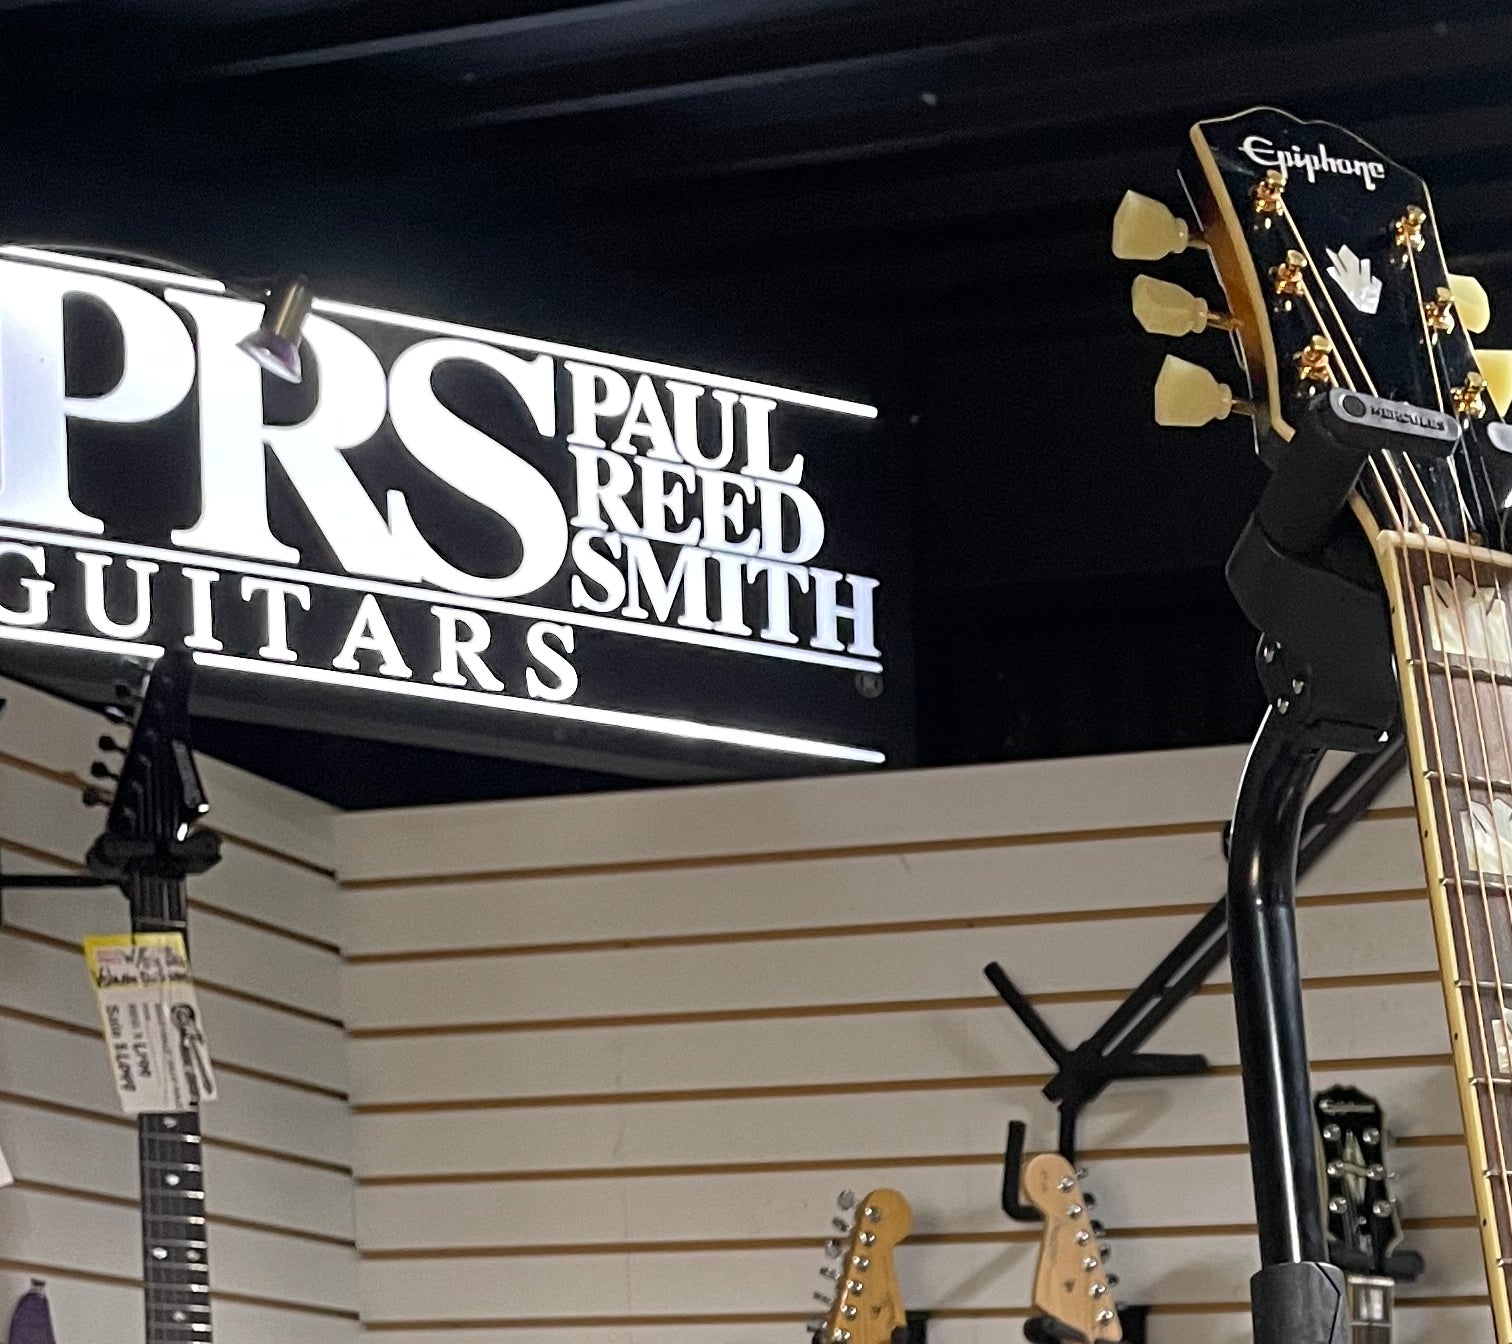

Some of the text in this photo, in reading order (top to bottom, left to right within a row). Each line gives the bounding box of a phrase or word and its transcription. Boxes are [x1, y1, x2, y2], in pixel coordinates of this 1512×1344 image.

[1237, 135, 1386, 191] Epiphone
[0, 254, 569, 599] PRS
[565, 359, 804, 485] PAUL
[1370, 405, 1446, 432] HERCULES
[567, 444, 825, 564] REED
[0, 543, 579, 701] GUITARS
[570, 530, 882, 658] SMITH
